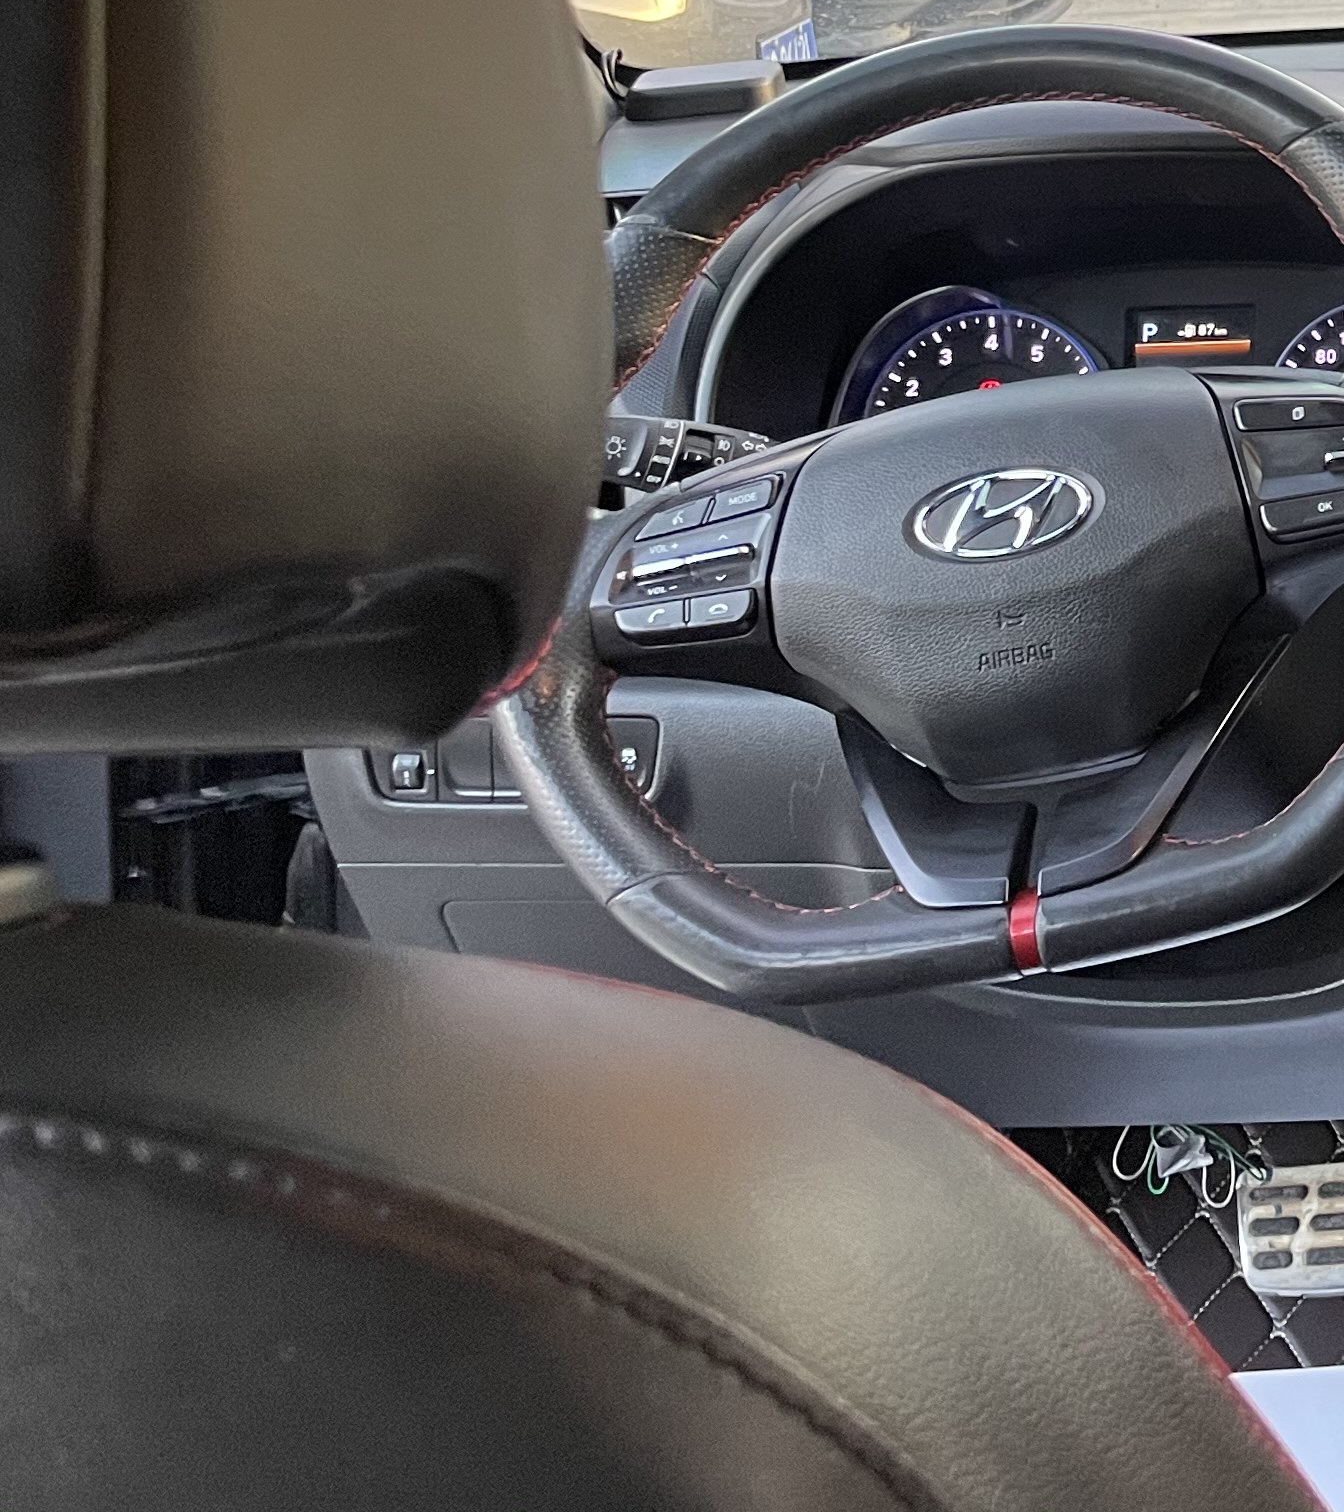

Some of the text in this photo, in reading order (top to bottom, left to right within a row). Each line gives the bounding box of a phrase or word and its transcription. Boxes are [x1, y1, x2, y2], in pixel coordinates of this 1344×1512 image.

[1142, 323, 1158, 342] P
[984, 334, 999, 351] 4
[938, 348, 953, 366] 3
[1031, 345, 1045, 363] 5
[1315, 349, 1337, 365] 80
[905, 379, 920, 397] 2
[728, 492, 758, 506] MODE
[1317, 501, 1333, 513] OK
[978, 642, 1056, 672] AIRBAG
